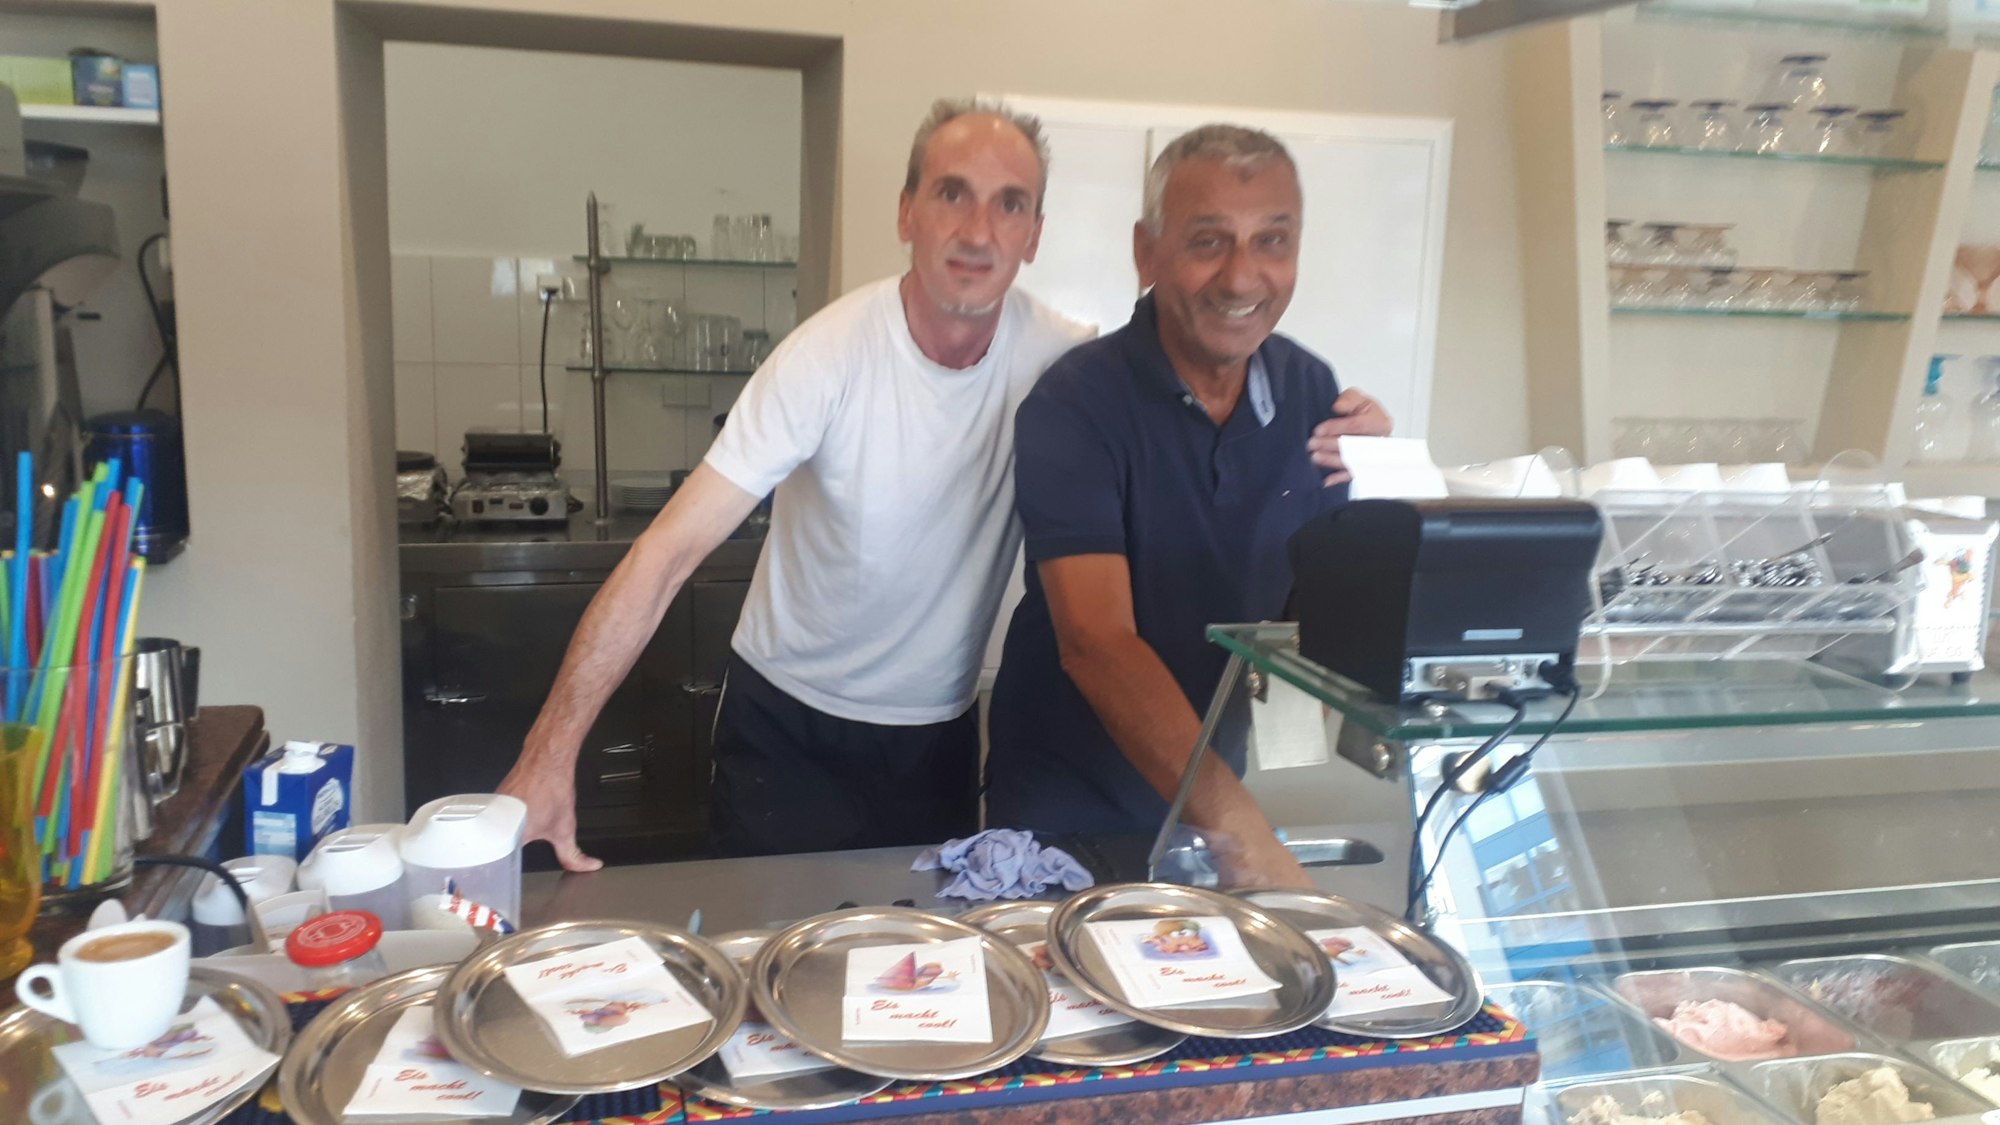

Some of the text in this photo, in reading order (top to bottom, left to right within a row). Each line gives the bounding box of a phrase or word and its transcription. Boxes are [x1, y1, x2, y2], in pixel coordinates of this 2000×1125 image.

[870, 999, 901, 1011] Eis
[889, 1008, 941, 1020] macht
[917, 1018, 959, 1029] cool!
[746, 1032, 775, 1046] Eis
[393, 1068, 429, 1082] Eis
[408, 1079, 469, 1093] macht
